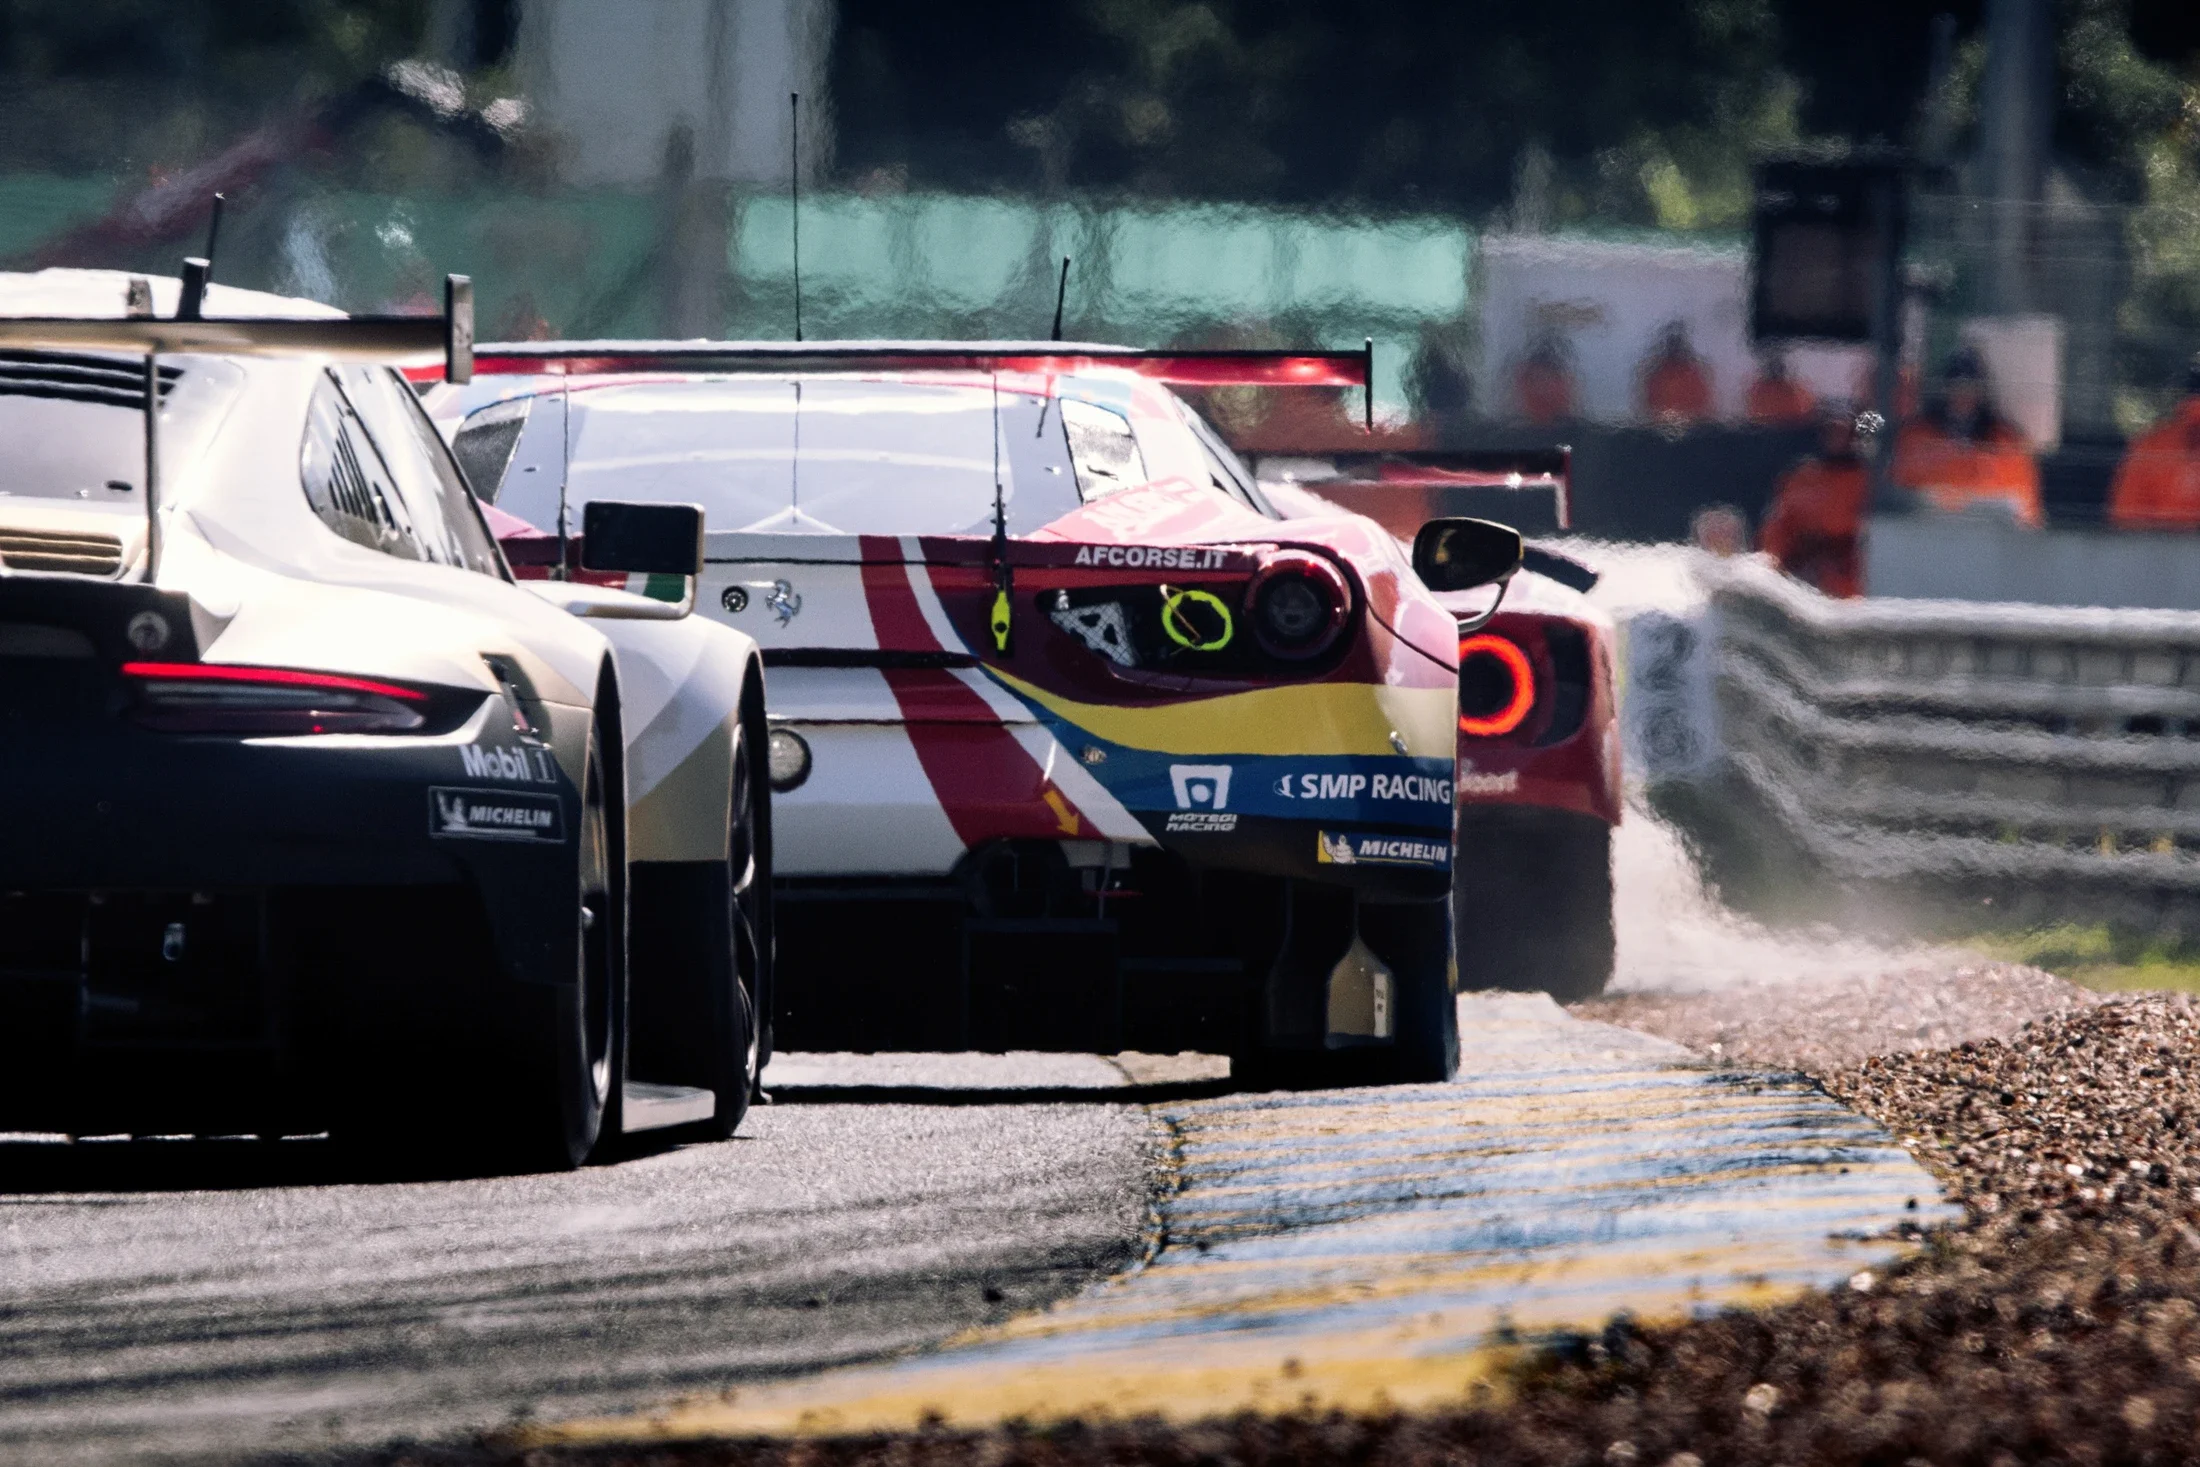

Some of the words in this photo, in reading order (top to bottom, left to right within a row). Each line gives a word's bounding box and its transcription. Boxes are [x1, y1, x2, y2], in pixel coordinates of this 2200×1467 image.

[1074, 545, 1228, 569] AFCORSE.IT
[459, 743, 532, 782] Mobil
[1300, 773, 1367, 800] SMP
[1371, 773, 1451, 805] RACING
[468, 804, 553, 828] MICHELIN
[1165, 822, 1236, 832] RACING
[1168, 813, 1238, 823] MOTEGI
[1358, 839, 1448, 863] MICHELIN
